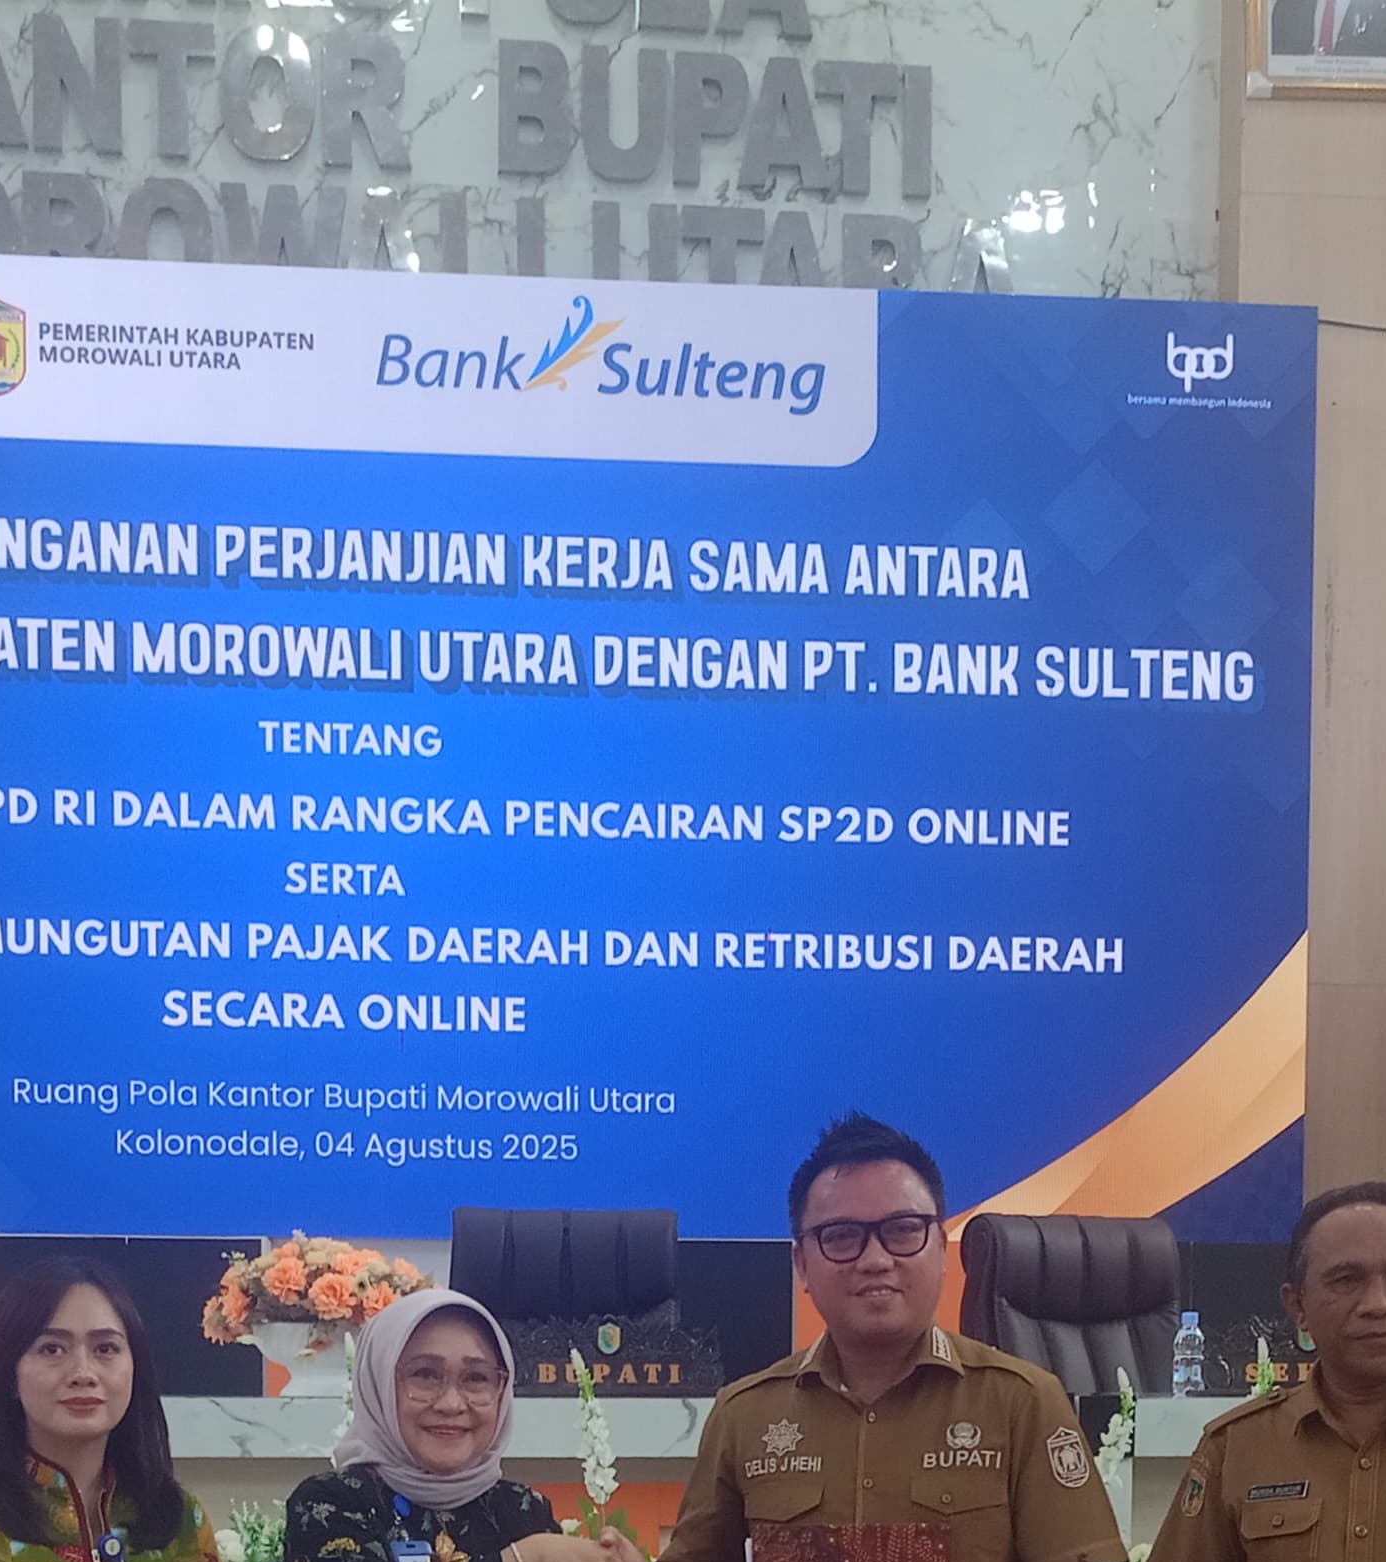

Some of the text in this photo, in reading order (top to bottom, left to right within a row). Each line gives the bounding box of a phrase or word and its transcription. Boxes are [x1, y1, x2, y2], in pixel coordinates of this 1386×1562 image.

[498, 39, 932, 200] BUPATI
[39, 322, 315, 351] PEMERINTAH KABUPATEN
[38, 346, 241, 370] MOROWALI UTARA
[376, 334, 827, 415] Bank Sulteng
[1127, 393, 1166, 406] bersama
[1168, 396, 1226, 408] membangun
[216, 526, 505, 584] PERJANJIAN
[524, 536, 672, 589] KERJA
[690, 541, 828, 593] SAMA
[845, 545, 1029, 598] ANTARA
[133, 622, 401, 679] MOROWALI
[420, 631, 577, 684] UTARA
[595, 636, 786, 689] DENGAN
[805, 641, 876, 691] PT.
[895, 643, 1018, 695] BANK
[1036, 647, 1253, 701] SULTENG
[259, 721, 441, 756] TENTANG
[55, 790, 94, 825] RI
[114, 791, 275, 829] DALAM
[293, 796, 490, 834] RANGKA
[506, 801, 762, 840] PENCAIRAN
[779, 806, 893, 842] SP2D
[909, 808, 1069, 845] ONLINE
[285, 862, 405, 895] SERTA
[249, 923, 391, 960] PAJAK
[409, 927, 587, 964] DAERAH
[606, 931, 697, 966] DAN
[716, 933, 932, 969] RETRIBUSI
[952, 937, 1122, 972] DAERAH
[163, 990, 525, 1031] SECARA ONLINE
[14, 1079, 674, 1116] Ruang Pola Kantor Bupati Morowali Utara
[117, 1129, 577, 1166] Kolonodale, 04 Agustus 2025
[744, 1457, 777, 1478] DELIS
[780, 1456, 788, 1472] J
[922, 1449, 1002, 1469] BUPATI
